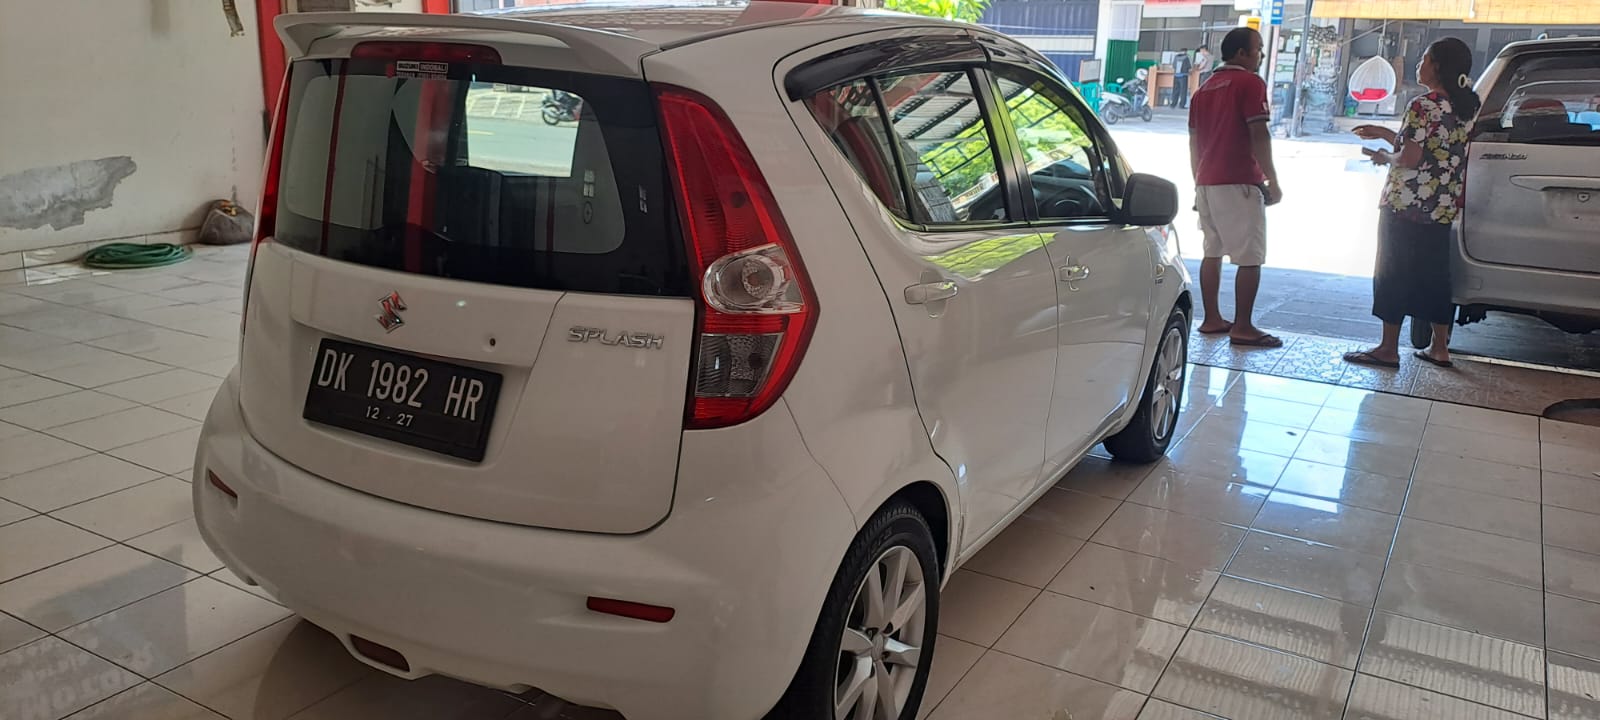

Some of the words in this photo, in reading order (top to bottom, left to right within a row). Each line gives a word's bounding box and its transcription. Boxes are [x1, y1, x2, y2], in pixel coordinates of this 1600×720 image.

[567, 325, 665, 350] SPLASH
[317, 348, 354, 392] DK
[367, 359, 429, 408] 1982
[443, 375, 484, 421] HR
[366, 405, 380, 420] 12
[396, 412, 414, 427] 27
